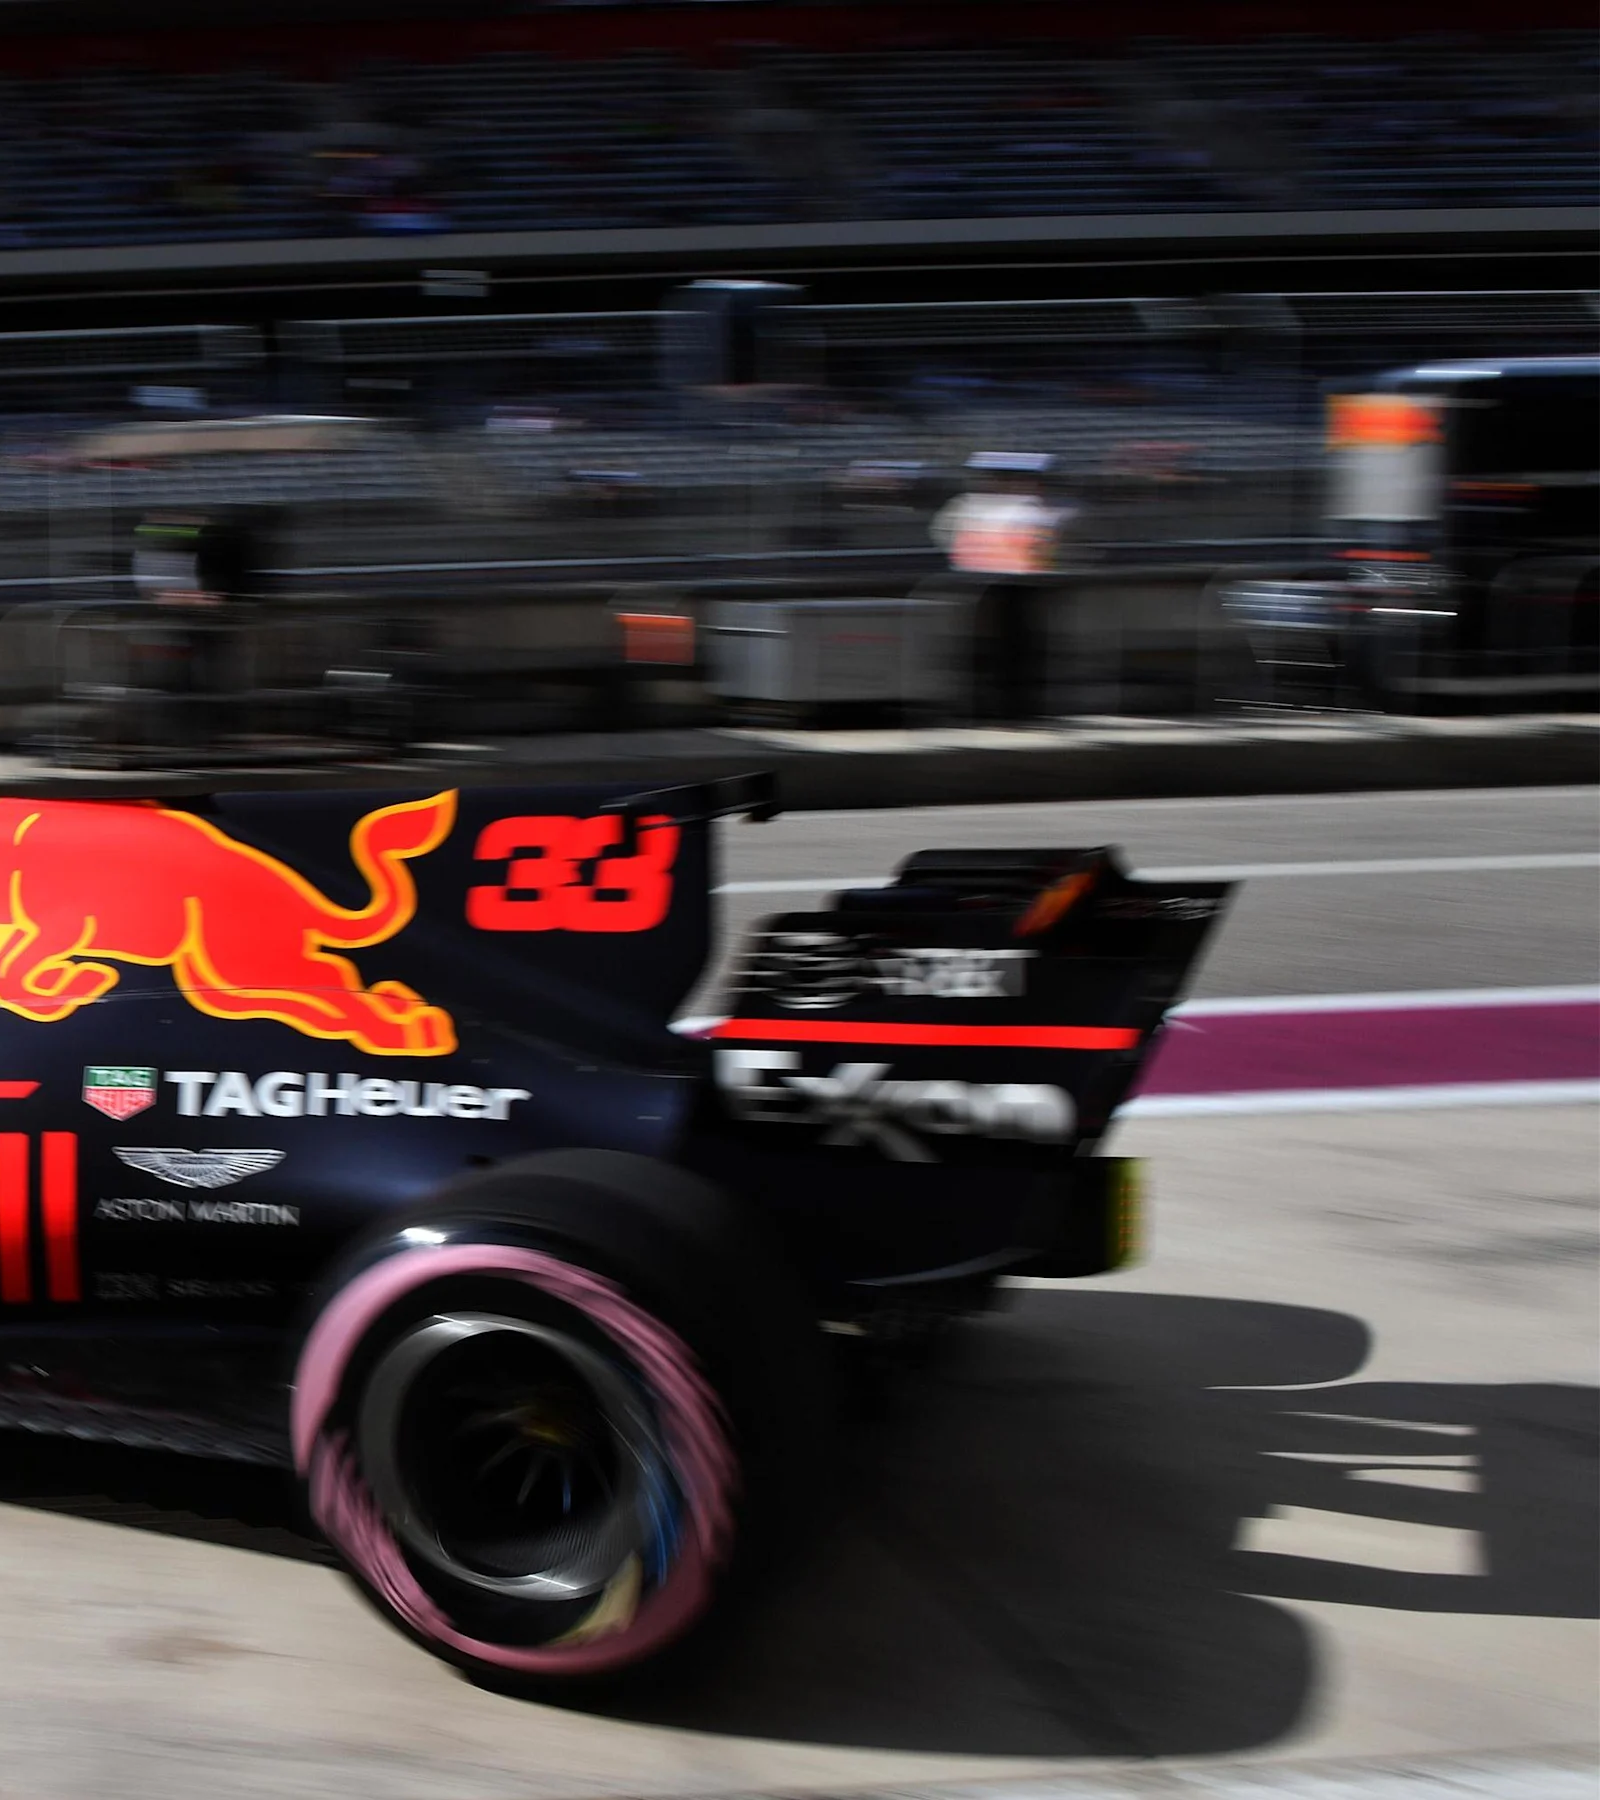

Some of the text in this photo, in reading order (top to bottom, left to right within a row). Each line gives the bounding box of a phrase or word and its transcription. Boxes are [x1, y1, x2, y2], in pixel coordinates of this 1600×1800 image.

[466, 814, 681, 932] 33
[89, 1070, 151, 1087] TAG
[93, 1198, 300, 1227] ASTON MARTIN
